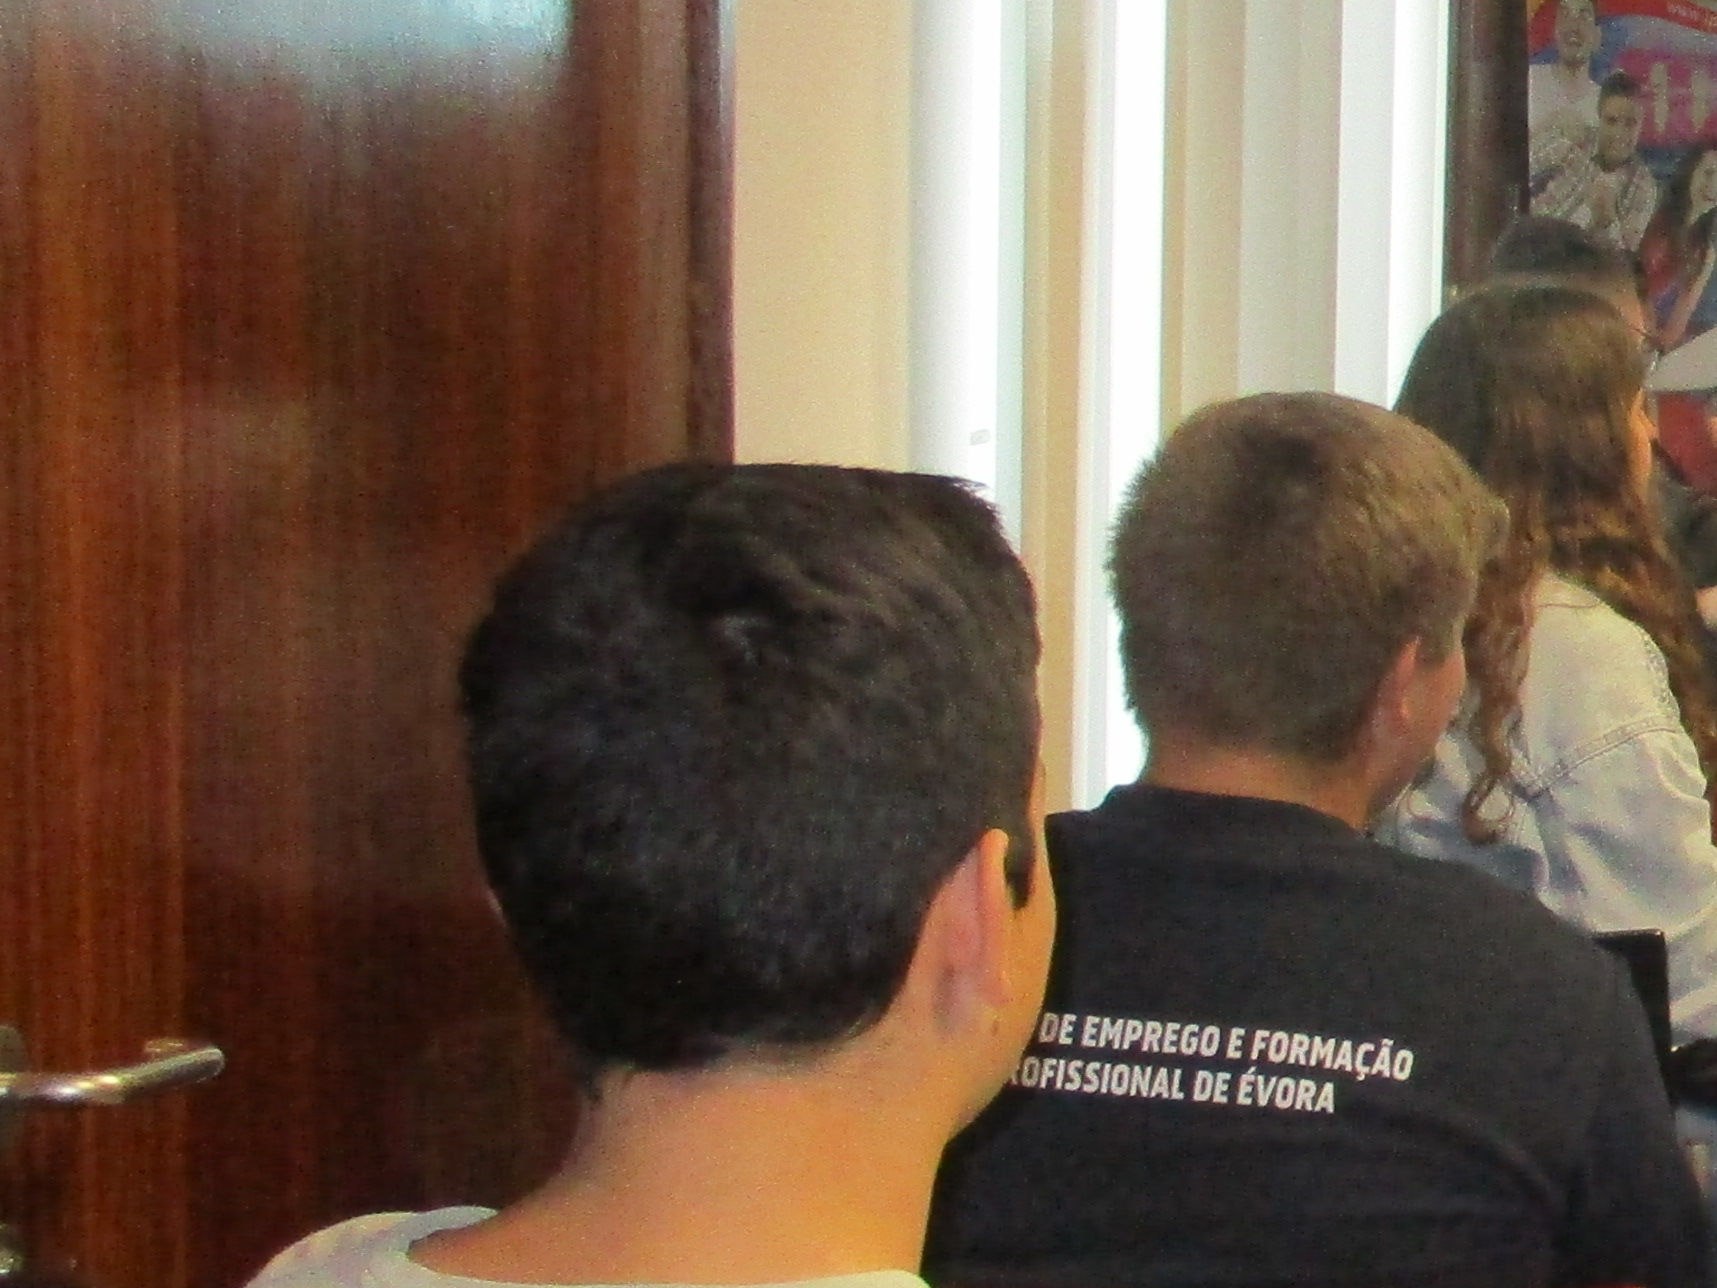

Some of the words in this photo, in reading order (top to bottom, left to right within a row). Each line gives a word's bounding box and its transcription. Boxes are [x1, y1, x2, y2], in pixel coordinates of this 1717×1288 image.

[1038, 1012, 1077, 1044] DE
[1082, 1015, 1219, 1058] EMPREGO
[1226, 1028, 1246, 1059] E
[1250, 1029, 1415, 1081] FORMAÇÃO
[1193, 1069, 1229, 1104] DE
[1237, 1067, 1336, 1113] ÉVORA
